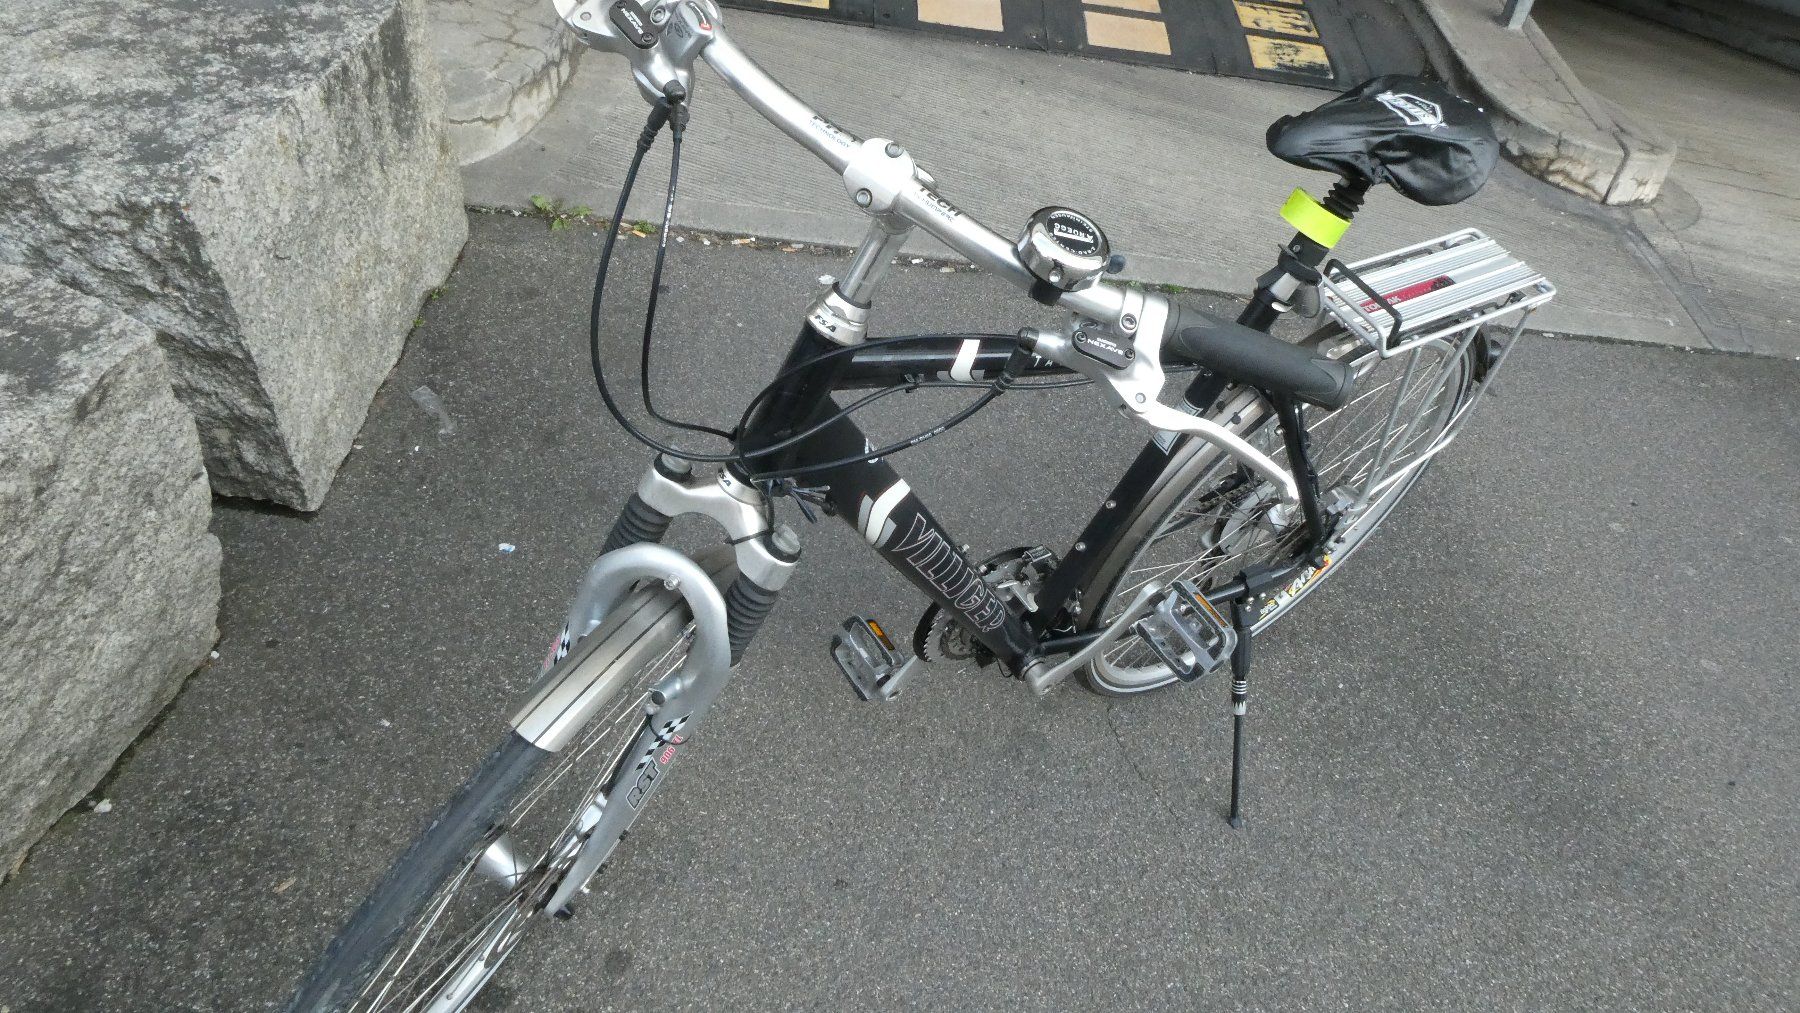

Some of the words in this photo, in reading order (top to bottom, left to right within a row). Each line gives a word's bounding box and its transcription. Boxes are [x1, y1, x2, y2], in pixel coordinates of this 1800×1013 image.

[814, 314, 837, 333] FSA
[892, 512, 1005, 631] VILLIGER
[659, 745, 675, 765] 906
[625, 759, 660, 810] RST
